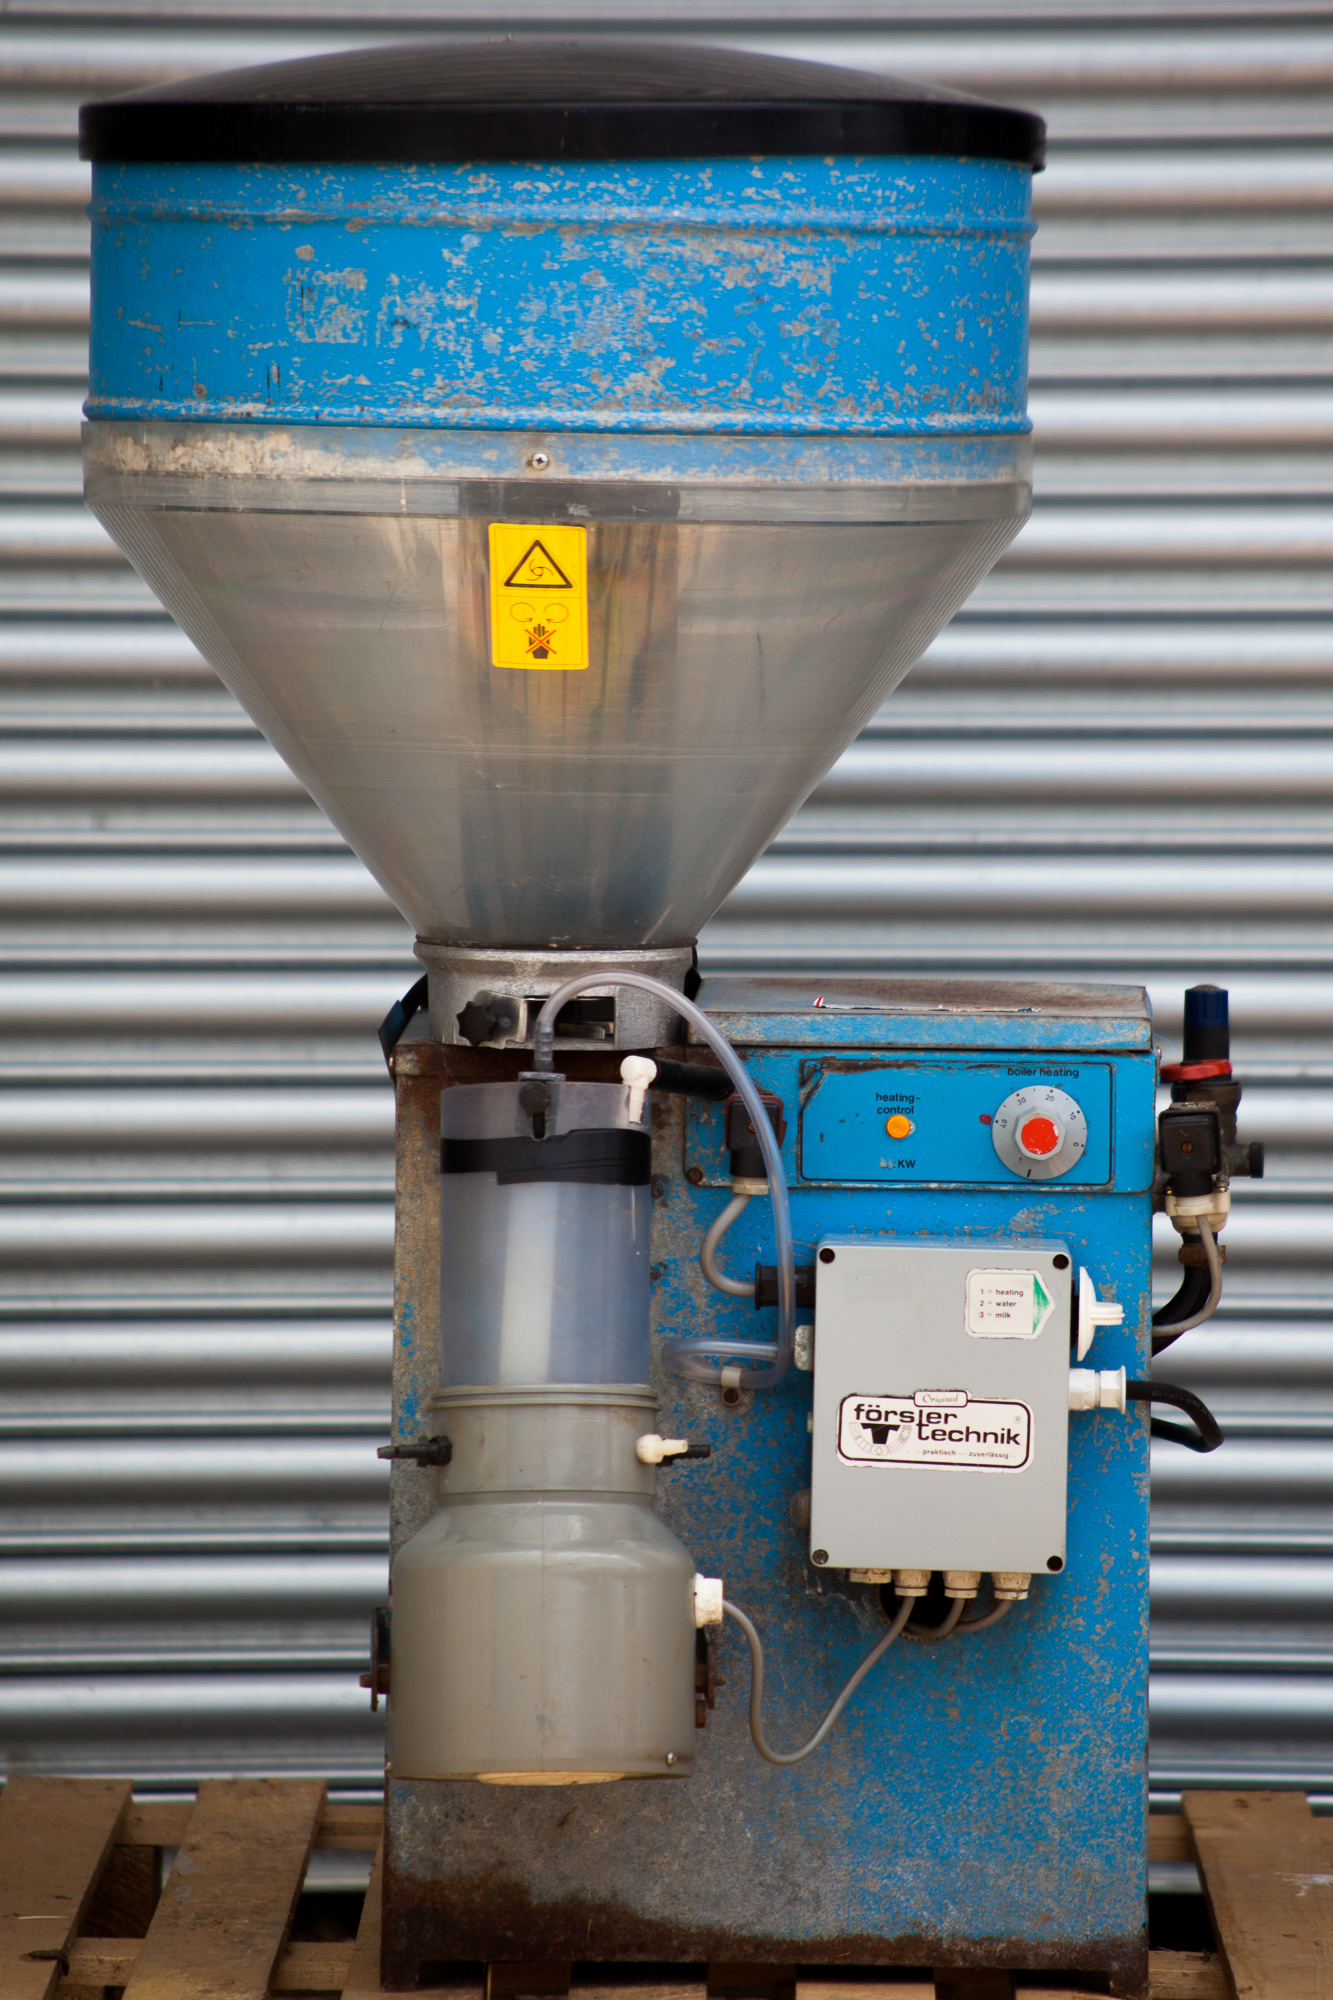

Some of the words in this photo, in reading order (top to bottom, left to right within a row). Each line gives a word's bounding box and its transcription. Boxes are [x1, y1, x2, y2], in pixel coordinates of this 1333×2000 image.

[1007, 1067, 1037, 1076] boiler
[1039, 1067, 1079, 1079] heating
[1017, 1097, 1027, 1106] 30
[1045, 1094, 1055, 1102] 20
[877, 1105, 914, 1115] control
[1069, 1112, 1077, 1121] 10
[1000, 1118, 1008, 1129] 40
[897, 1159, 916, 1169] KW
[995, 1289, 1024, 1298] heating
[922, 1394, 959, 1404] Original
[915, 1422, 1021, 1446] technik
[968, 1451, 1009, 1460] zuverlässig
